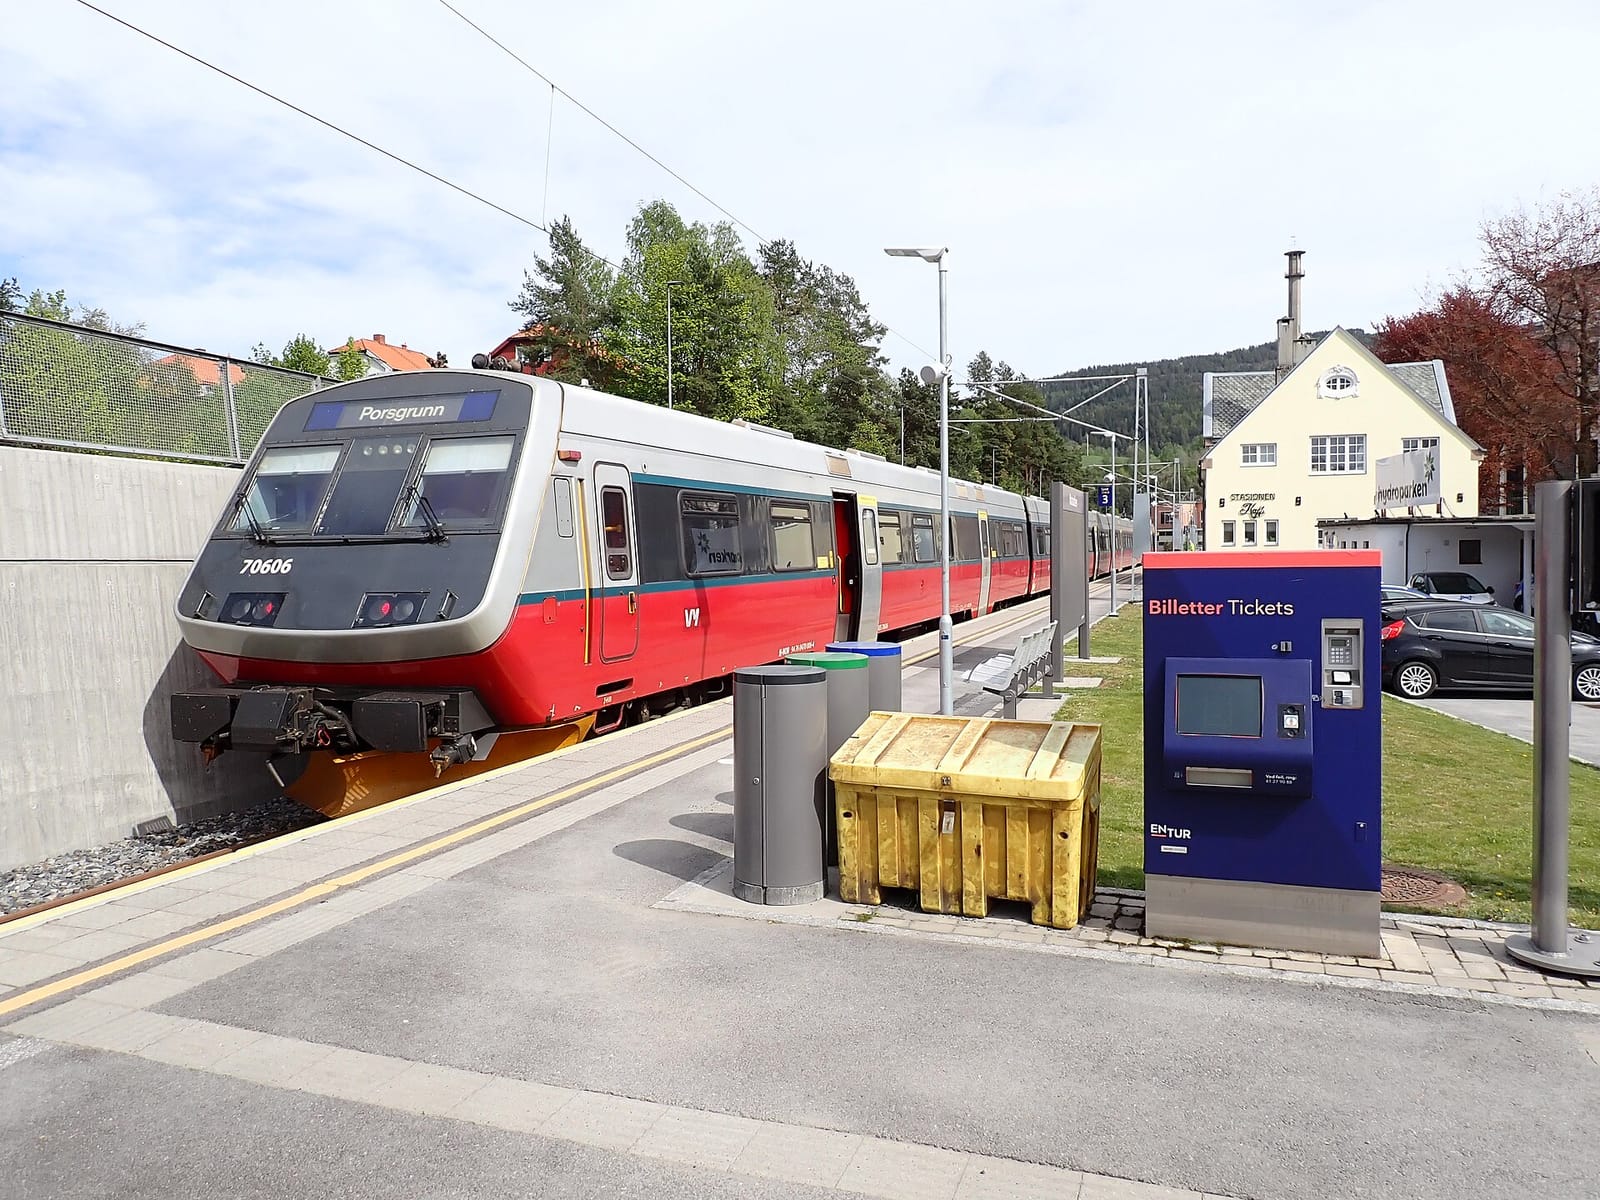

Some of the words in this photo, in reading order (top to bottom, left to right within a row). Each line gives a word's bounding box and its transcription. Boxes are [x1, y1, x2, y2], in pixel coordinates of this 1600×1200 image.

[359, 405, 445, 421] Porsgrunn
[1101, 494, 1109, 504] 3
[1230, 493, 1276, 501] STASIONEN
[1377, 480, 1428, 505] hydroparken
[239, 558, 294, 575] 70606
[1149, 599, 1224, 615] Billetter
[1227, 599, 1295, 615] Tickets
[1150, 823, 1192, 839] ENTUR
